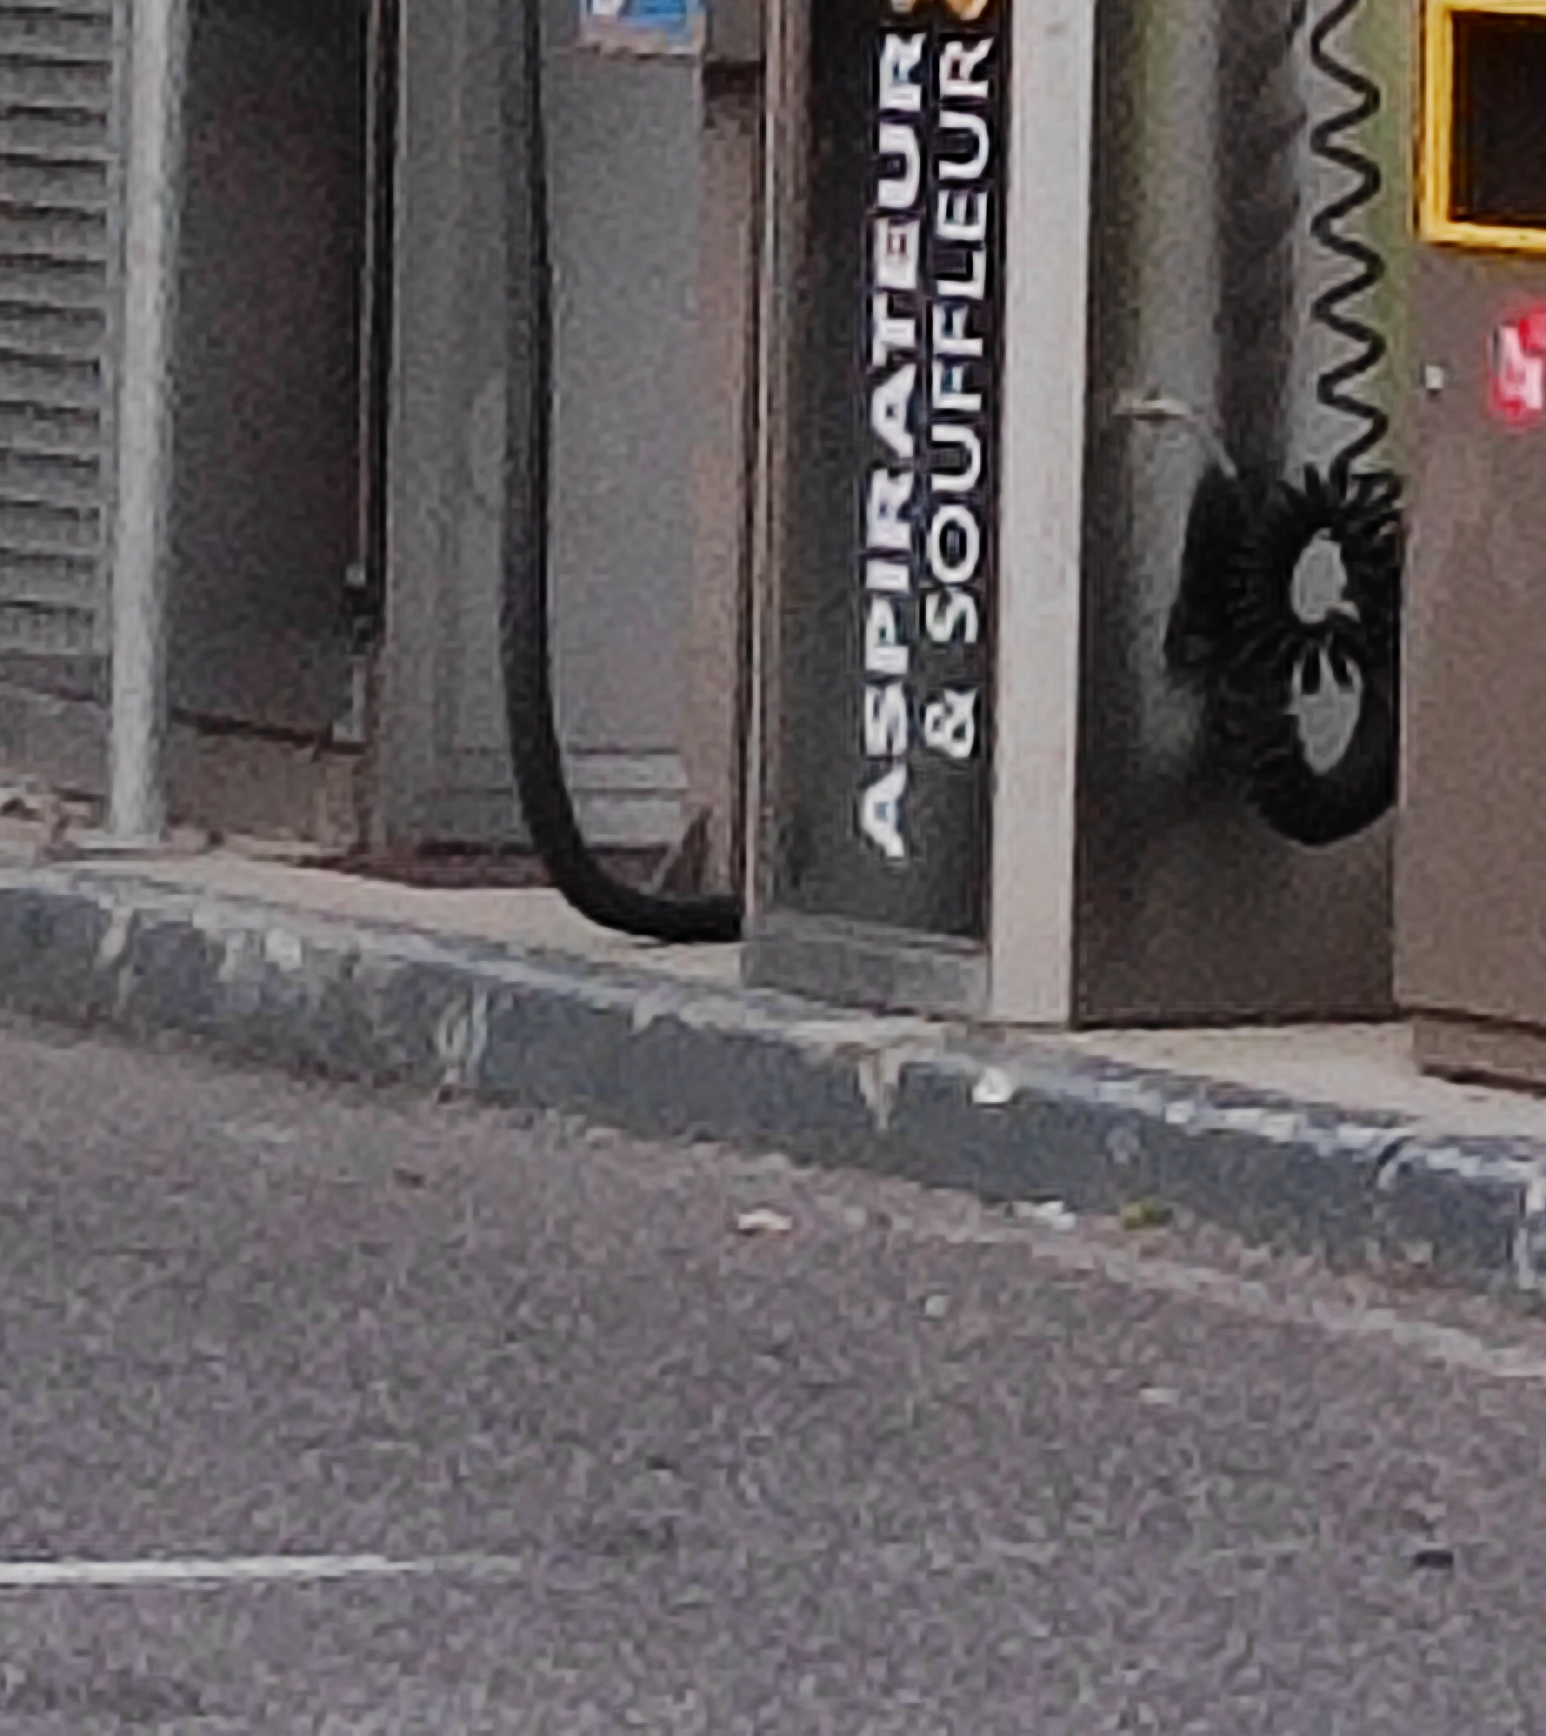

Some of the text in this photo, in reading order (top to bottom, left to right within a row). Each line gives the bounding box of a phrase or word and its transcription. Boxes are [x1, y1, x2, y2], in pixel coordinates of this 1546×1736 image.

[860, 32, 926, 857] ASPIRATEUR
[924, 37, 994, 758] & SOUFFLEUR
